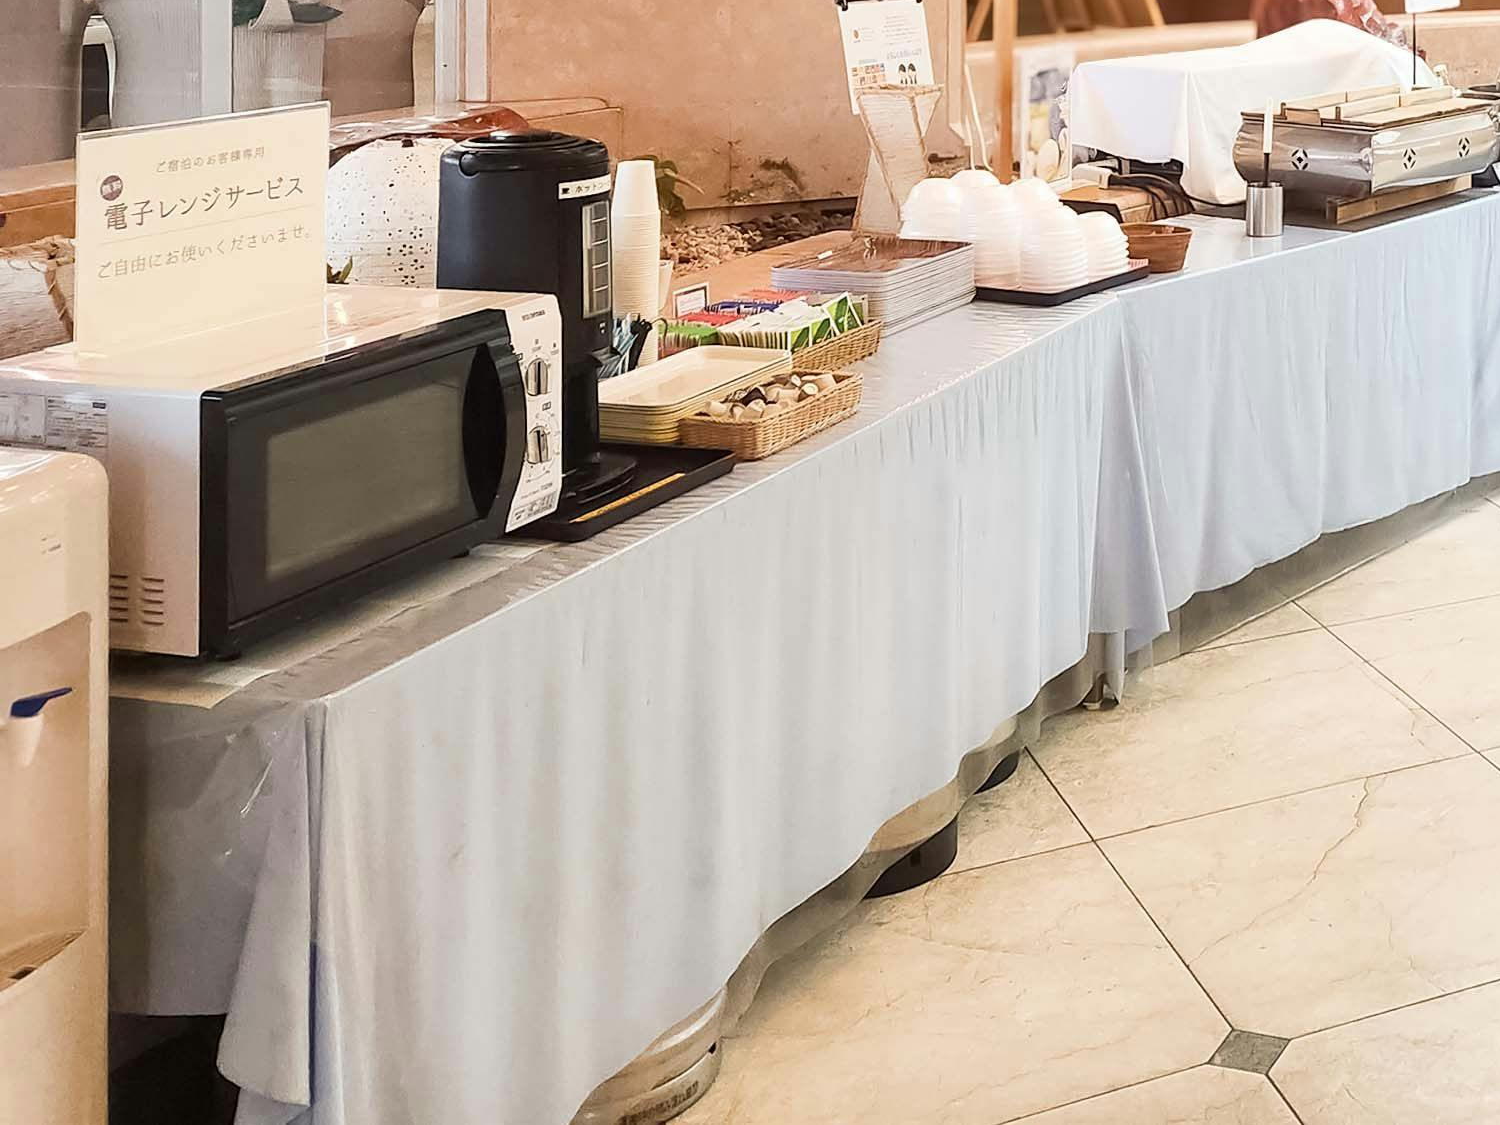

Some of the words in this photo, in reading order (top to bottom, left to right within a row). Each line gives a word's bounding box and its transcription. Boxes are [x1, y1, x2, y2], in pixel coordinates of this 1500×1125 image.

[156, 146, 266, 173] ご宿泊のお客様専用
[104, 177, 304, 231] 電子レンジサービス
[97, 225, 311, 279] ご自由にお使いくださいませ。
